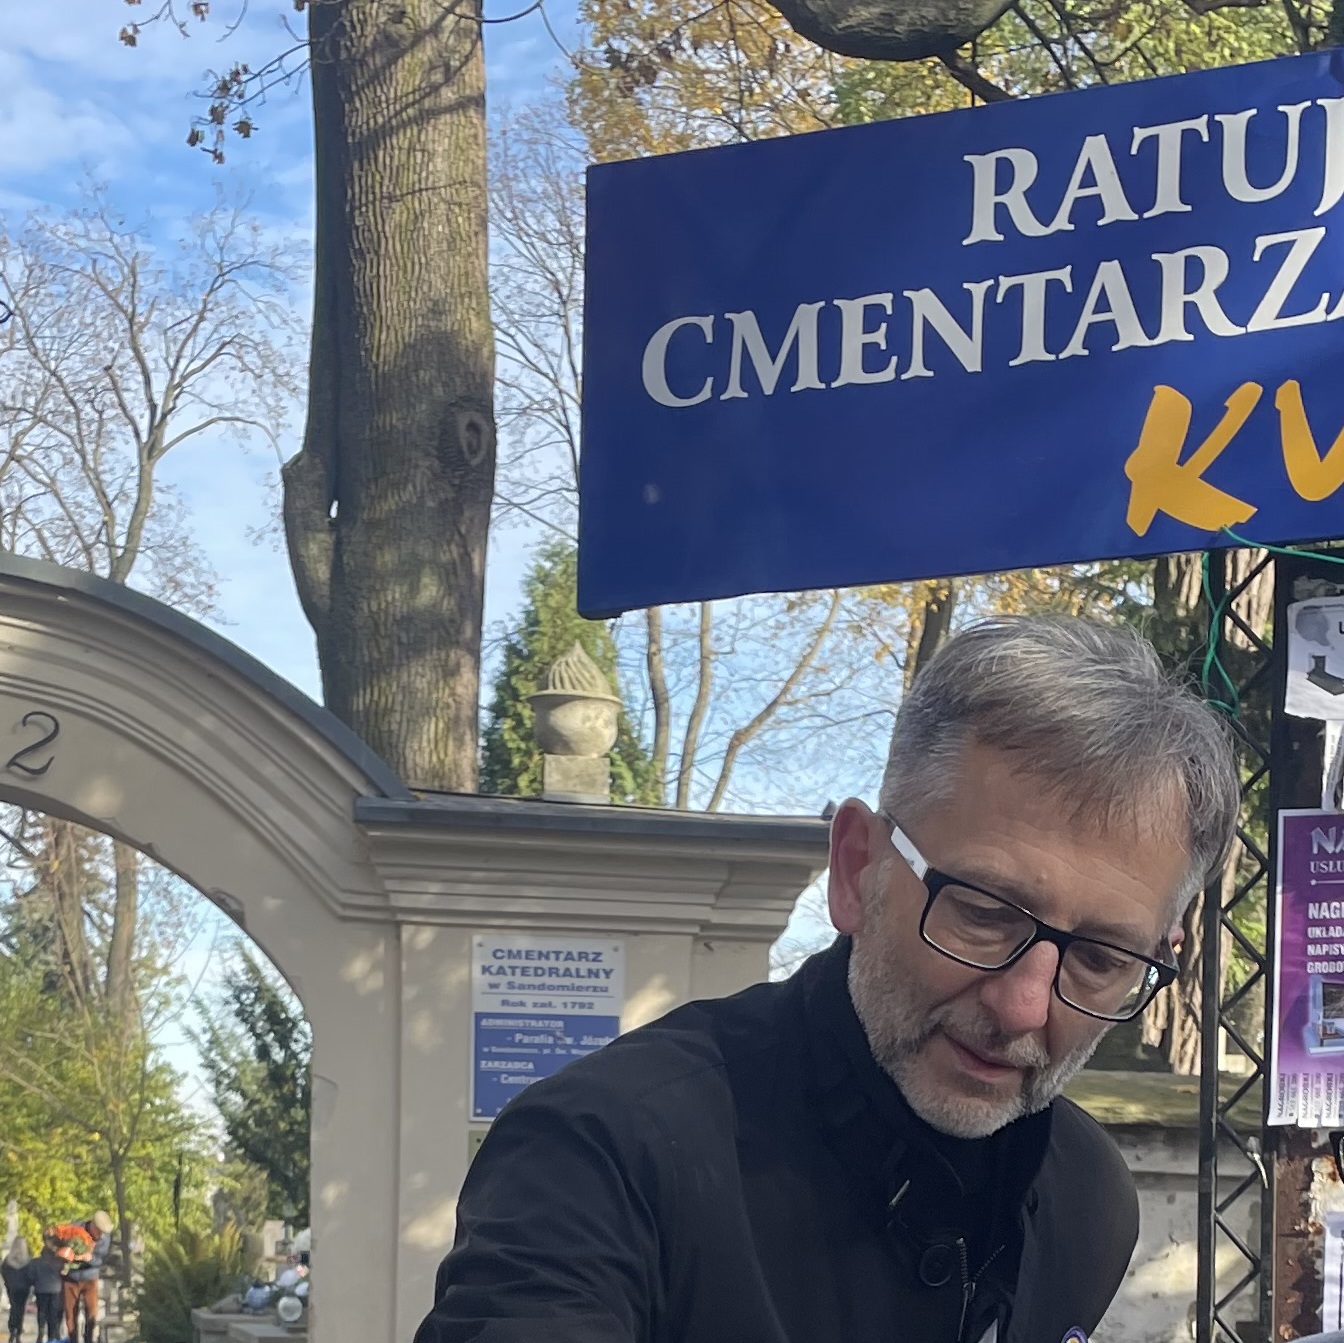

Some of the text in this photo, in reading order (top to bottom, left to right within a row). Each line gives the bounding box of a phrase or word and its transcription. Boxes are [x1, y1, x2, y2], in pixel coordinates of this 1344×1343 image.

[492, 948, 603, 963] CMENTARZ
[481, 965, 615, 979] KATEDRALNY
[488, 981, 609, 993] w Sandomierzu
[501, 999, 527, 1009] Rok
[562, 1001, 594, 1010] 1792
